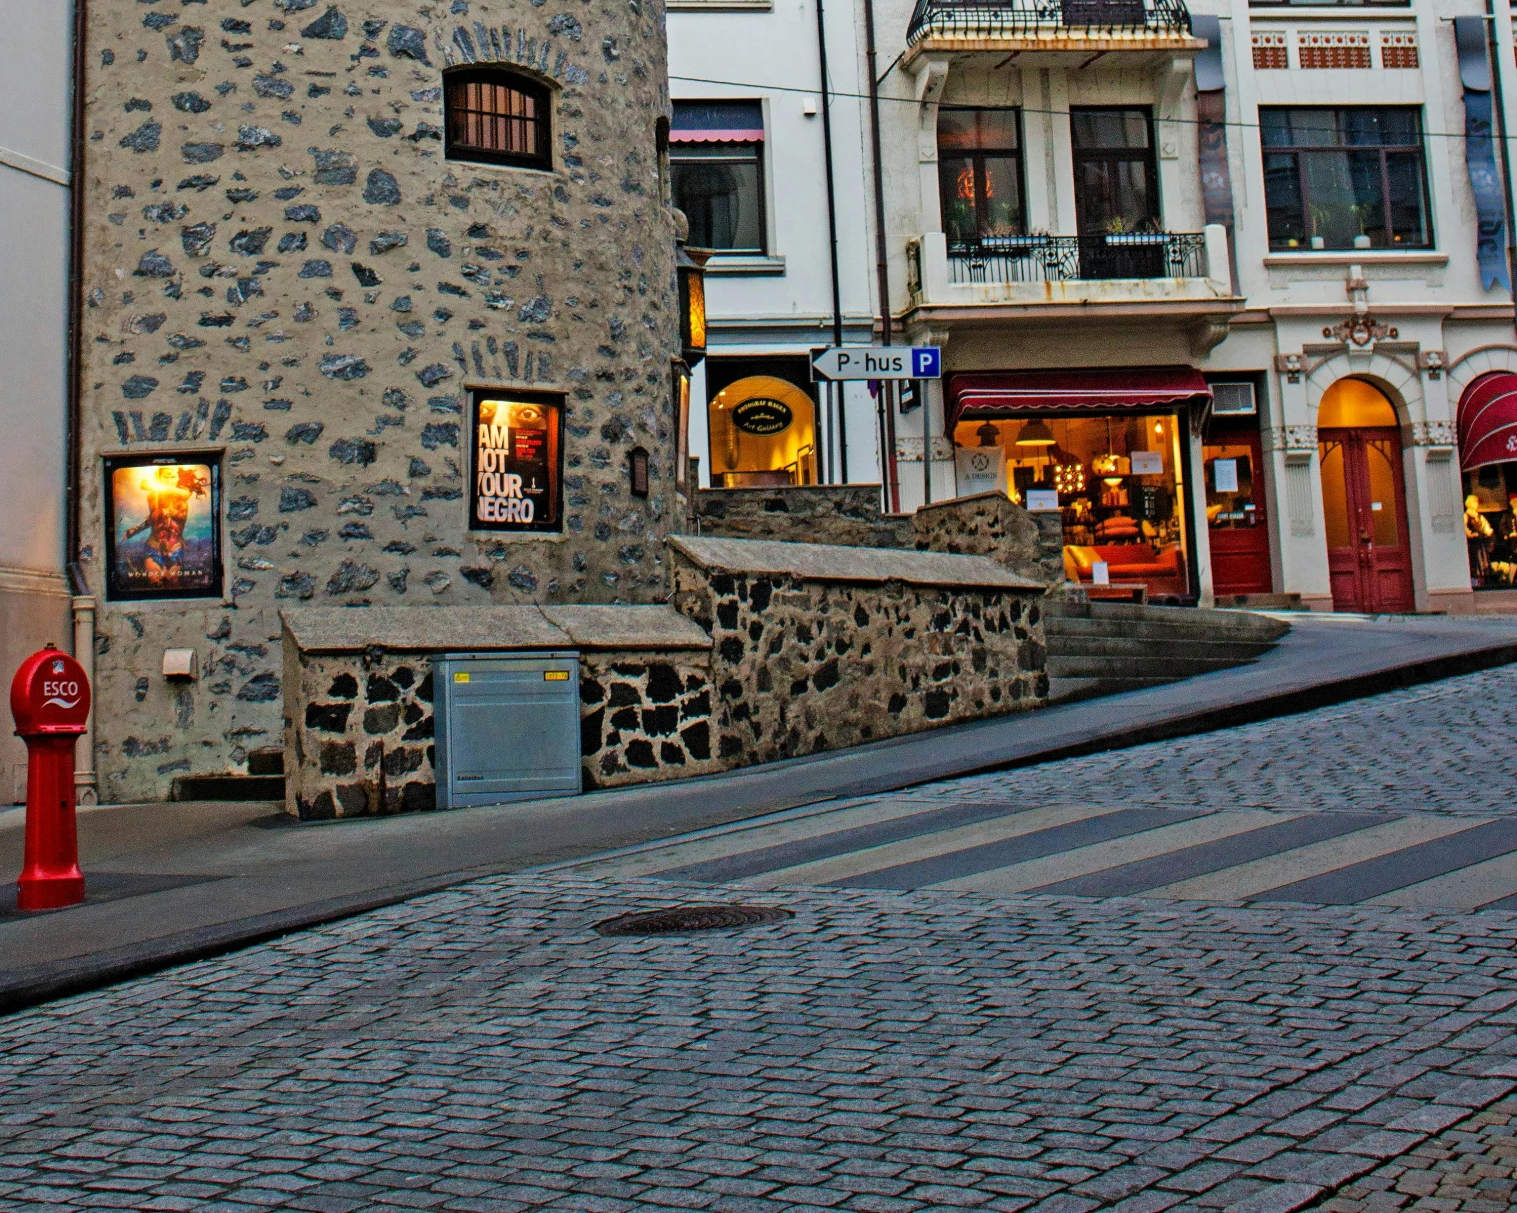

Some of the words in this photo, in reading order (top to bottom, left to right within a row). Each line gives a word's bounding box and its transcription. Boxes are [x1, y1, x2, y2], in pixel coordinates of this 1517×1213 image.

[919, 353, 933, 373] P
[479, 424, 509, 449] AM
[44, 681, 78, 696] ESCO
